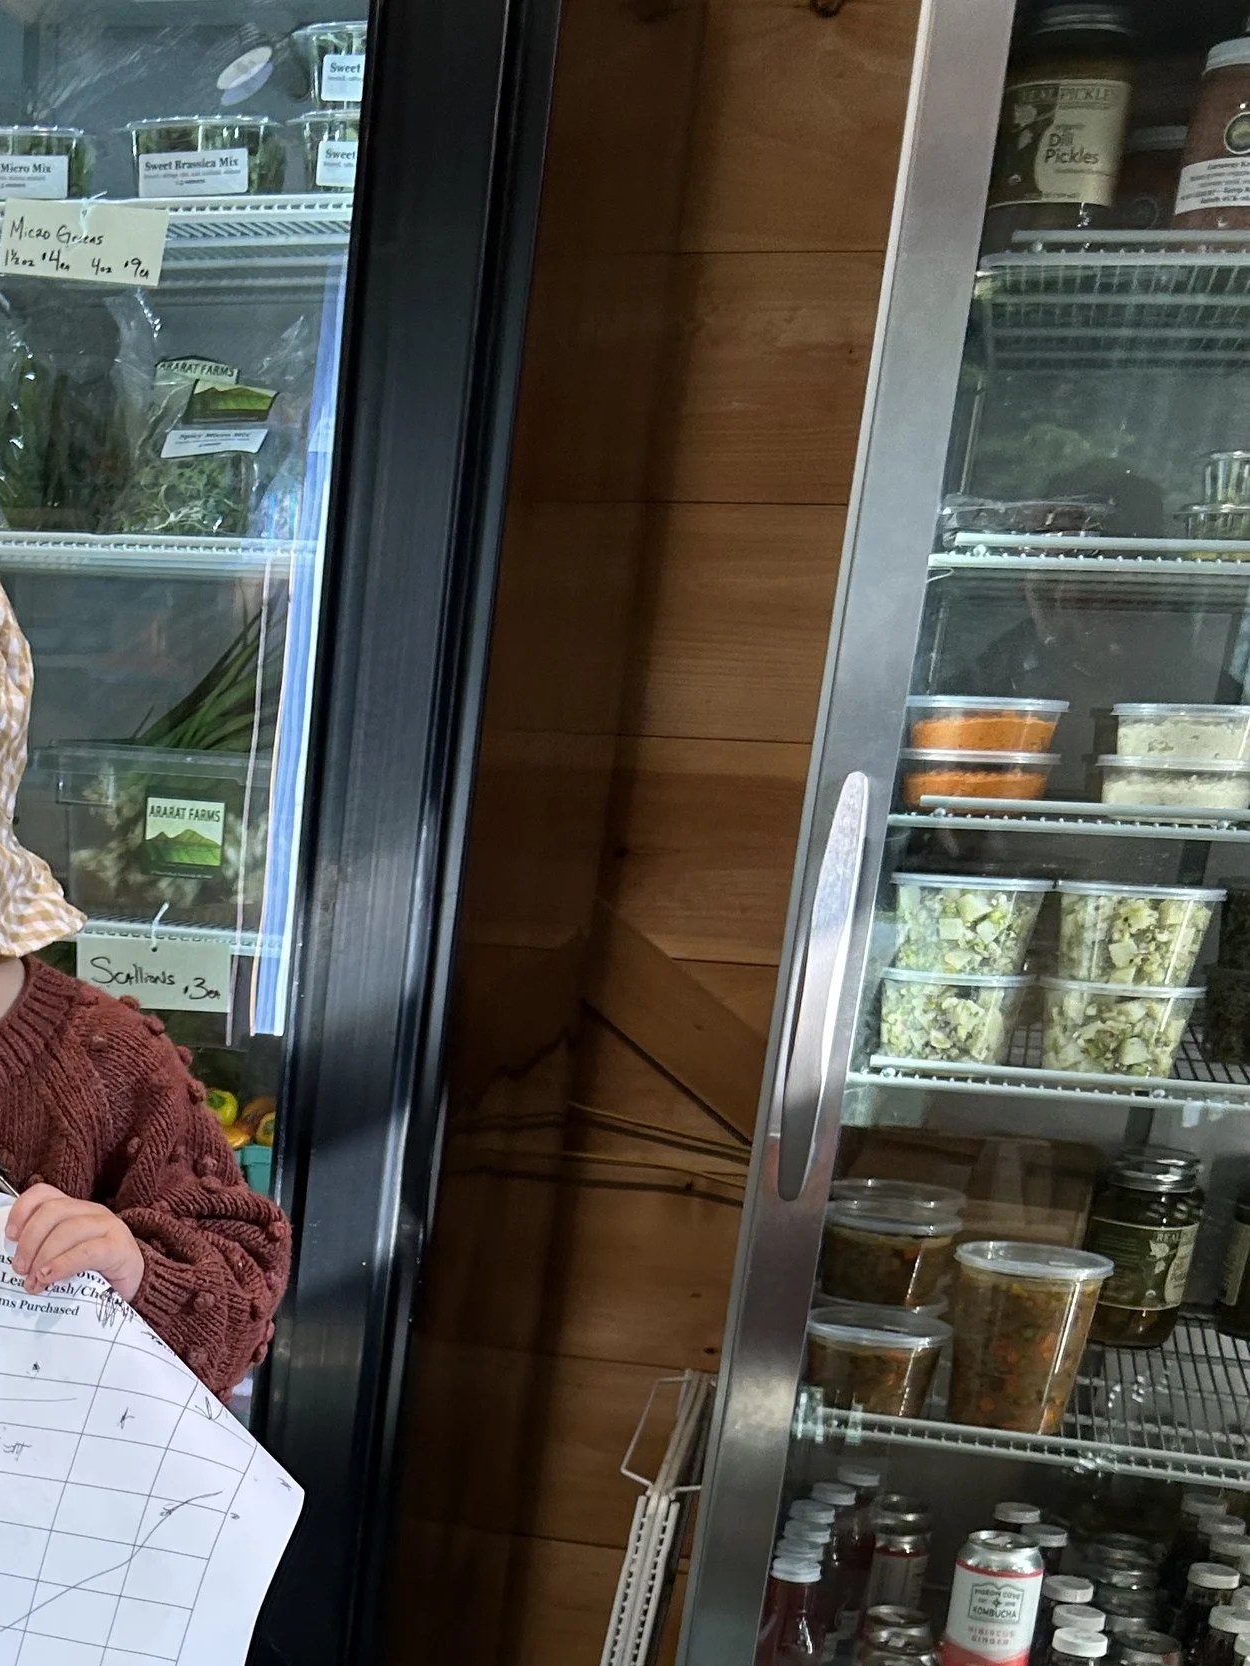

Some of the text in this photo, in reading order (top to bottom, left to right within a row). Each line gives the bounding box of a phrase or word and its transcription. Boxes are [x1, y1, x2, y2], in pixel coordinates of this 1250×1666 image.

[329, 61, 361, 73] Sweet
[1049, 133, 1074, 146] Dill
[324, 148, 356, 160] Sweet
[1044, 146, 1100, 164] Pickles
[0, 162, 32, 173] Micro
[34, 162, 52, 173] Mix
[144, 156, 239, 172] Sweet Brassica Mix
[9, 216, 104, 246] Micro Greens
[200, 362, 235, 378] FARMS
[148, 804, 221, 823] ARARAT FARMS
[90, 956, 176, 985] Scallions
[0, 1272, 25, 1288] Lea
[76, 1270, 106, 1286] own
[18, 1299, 81, 1317] Purchased
[972, 1606, 1017, 1618] KOMBUCHA
